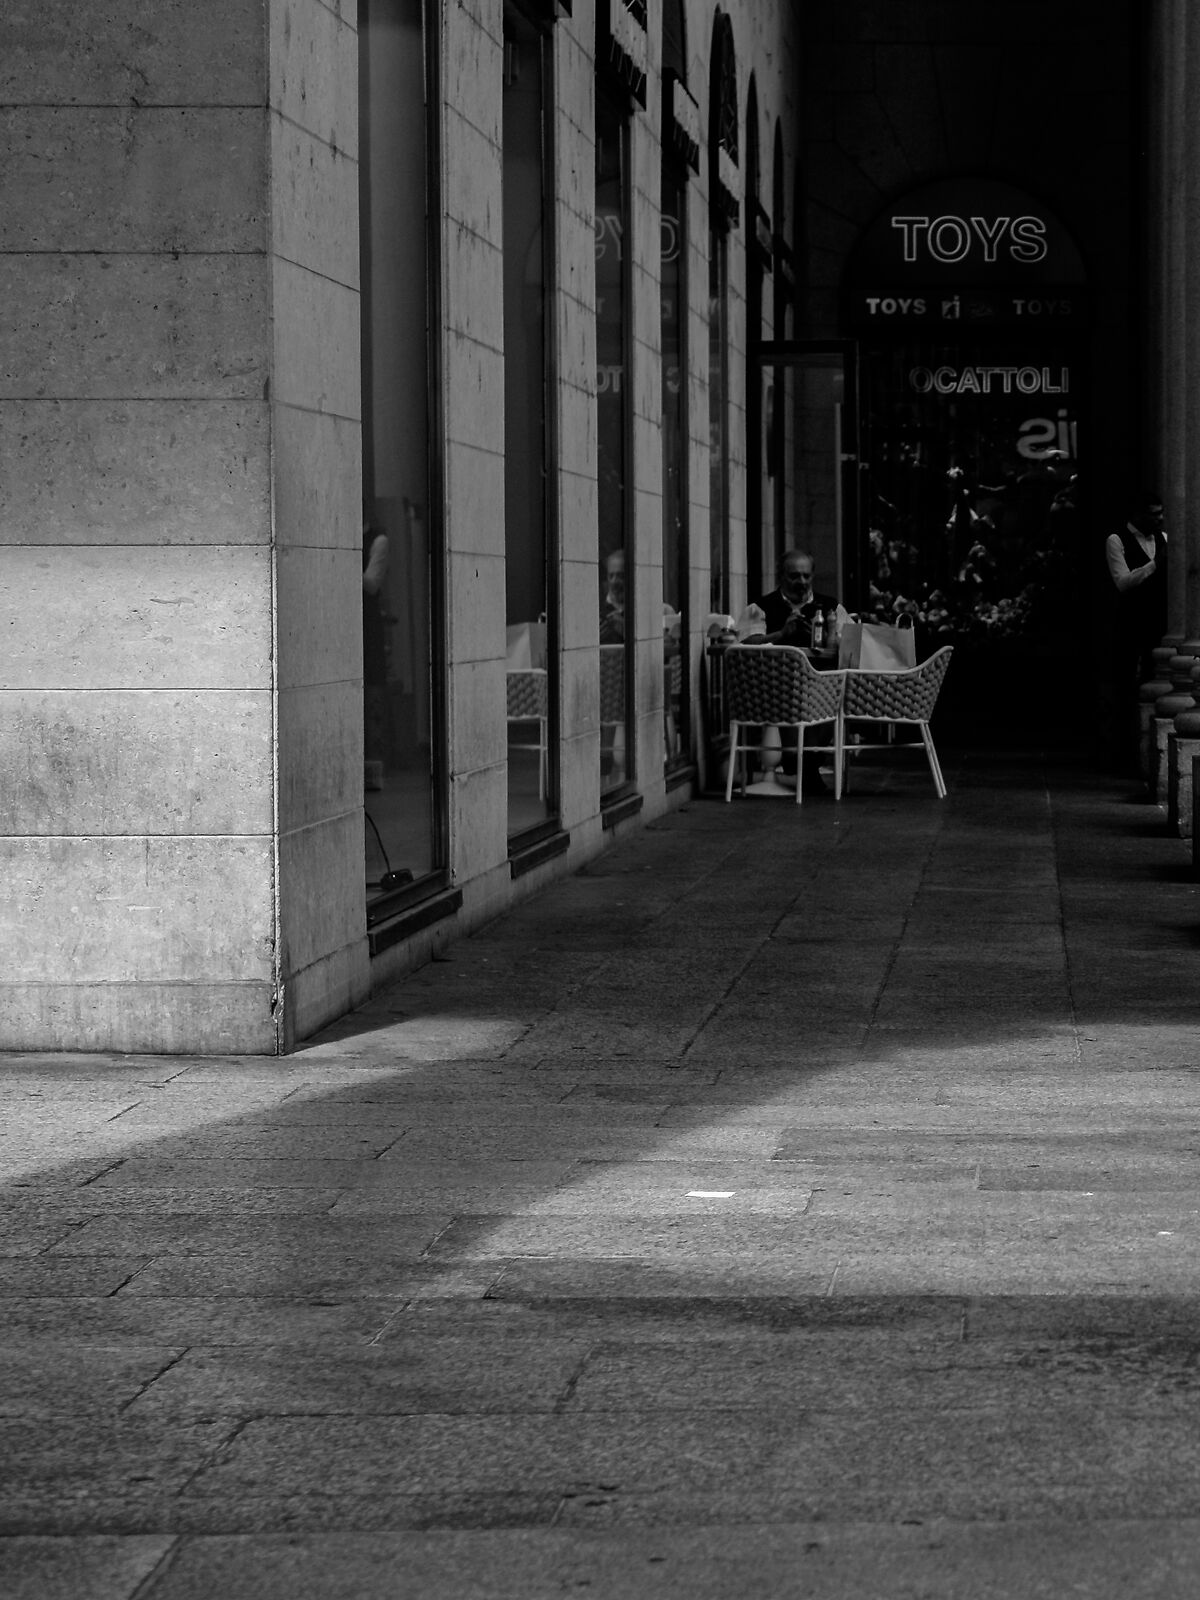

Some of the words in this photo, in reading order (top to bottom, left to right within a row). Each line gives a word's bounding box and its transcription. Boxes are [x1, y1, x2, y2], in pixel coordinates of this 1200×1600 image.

[891, 216, 1048, 263] TOYS
[866, 297, 927, 315] TOYS
[1012, 299, 1072, 315] TOYS
